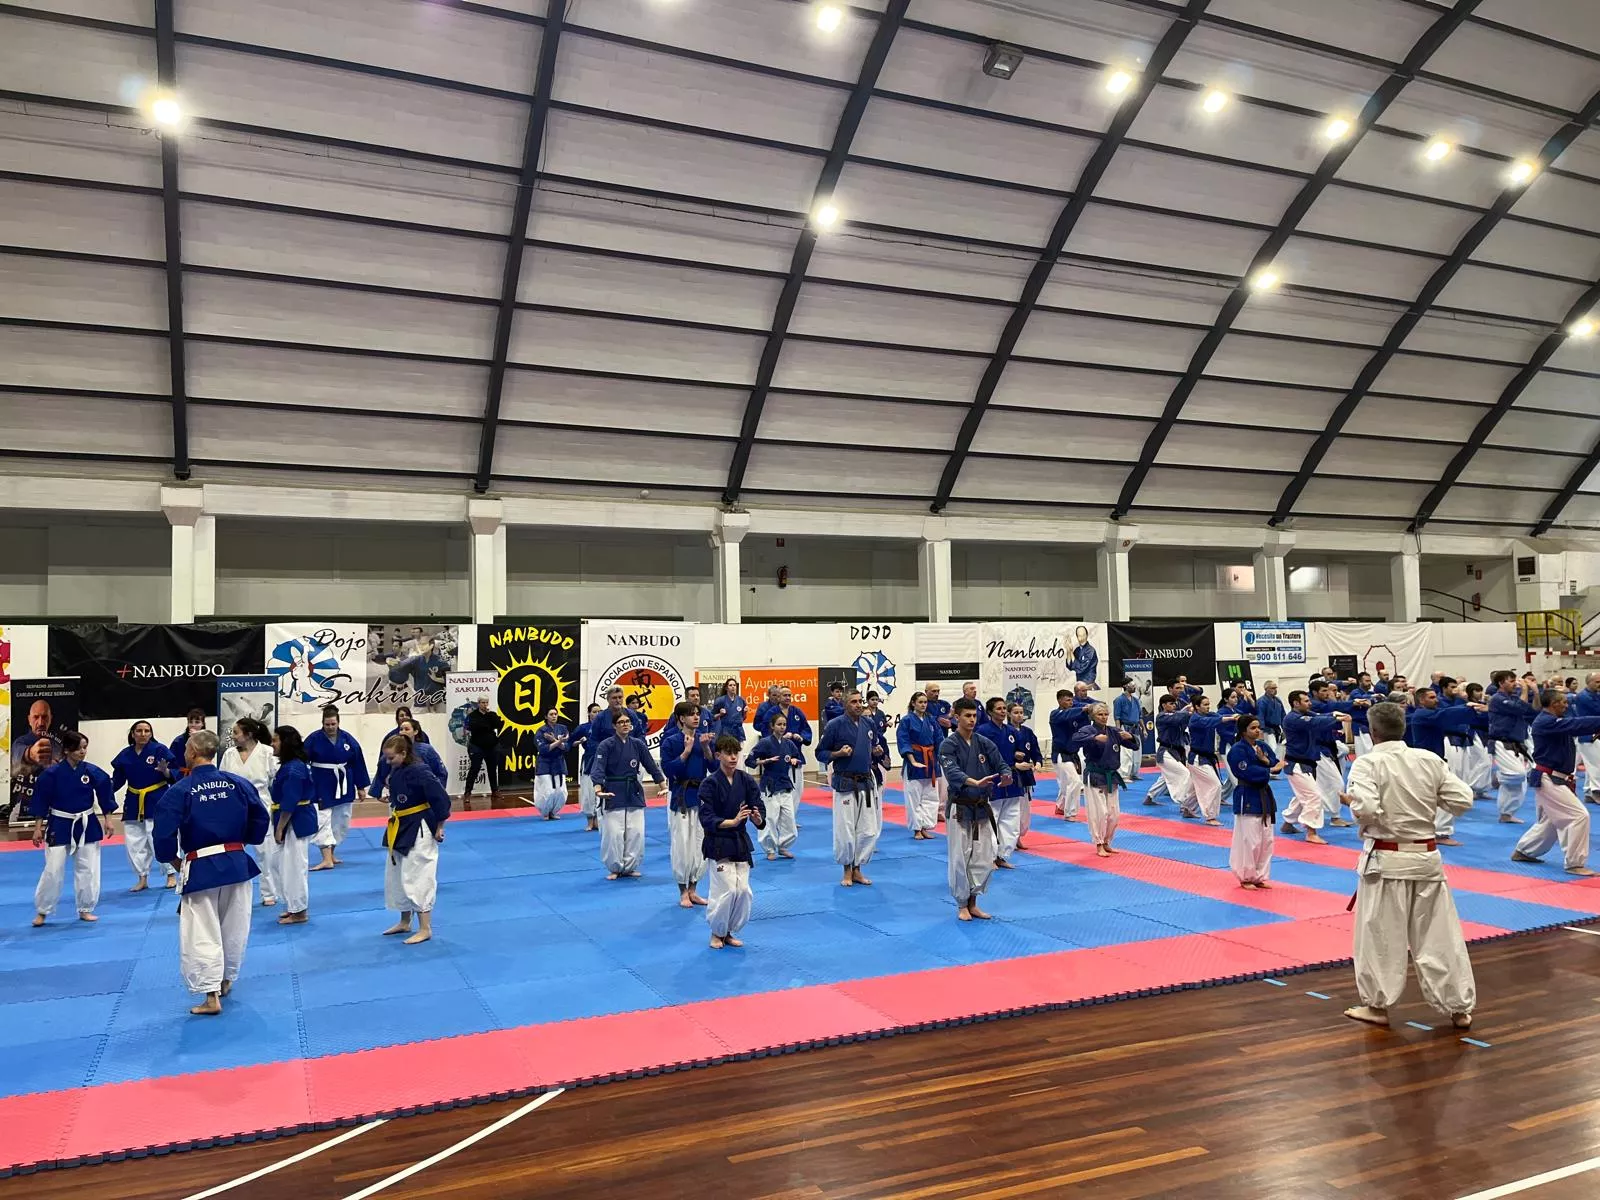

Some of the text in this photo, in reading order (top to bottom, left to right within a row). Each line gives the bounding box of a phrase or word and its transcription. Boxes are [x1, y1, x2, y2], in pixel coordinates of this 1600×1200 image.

[489, 626, 575, 650] NANBUDO
[606, 634, 681, 647] NANBUDO
[850, 625, 891, 640] DOJO
[313, 628, 366, 660] Dojo
[986, 636, 1065, 659] Nanbudo
[599, 658, 682, 700] ASOCIACIÓN ESPAÑOLA
[745, 677, 818, 691] Ayuntamient
[317, 673, 448, 708] Sakura
[746, 692, 760, 705] de
[190, 781, 236, 796] NANBUDO
